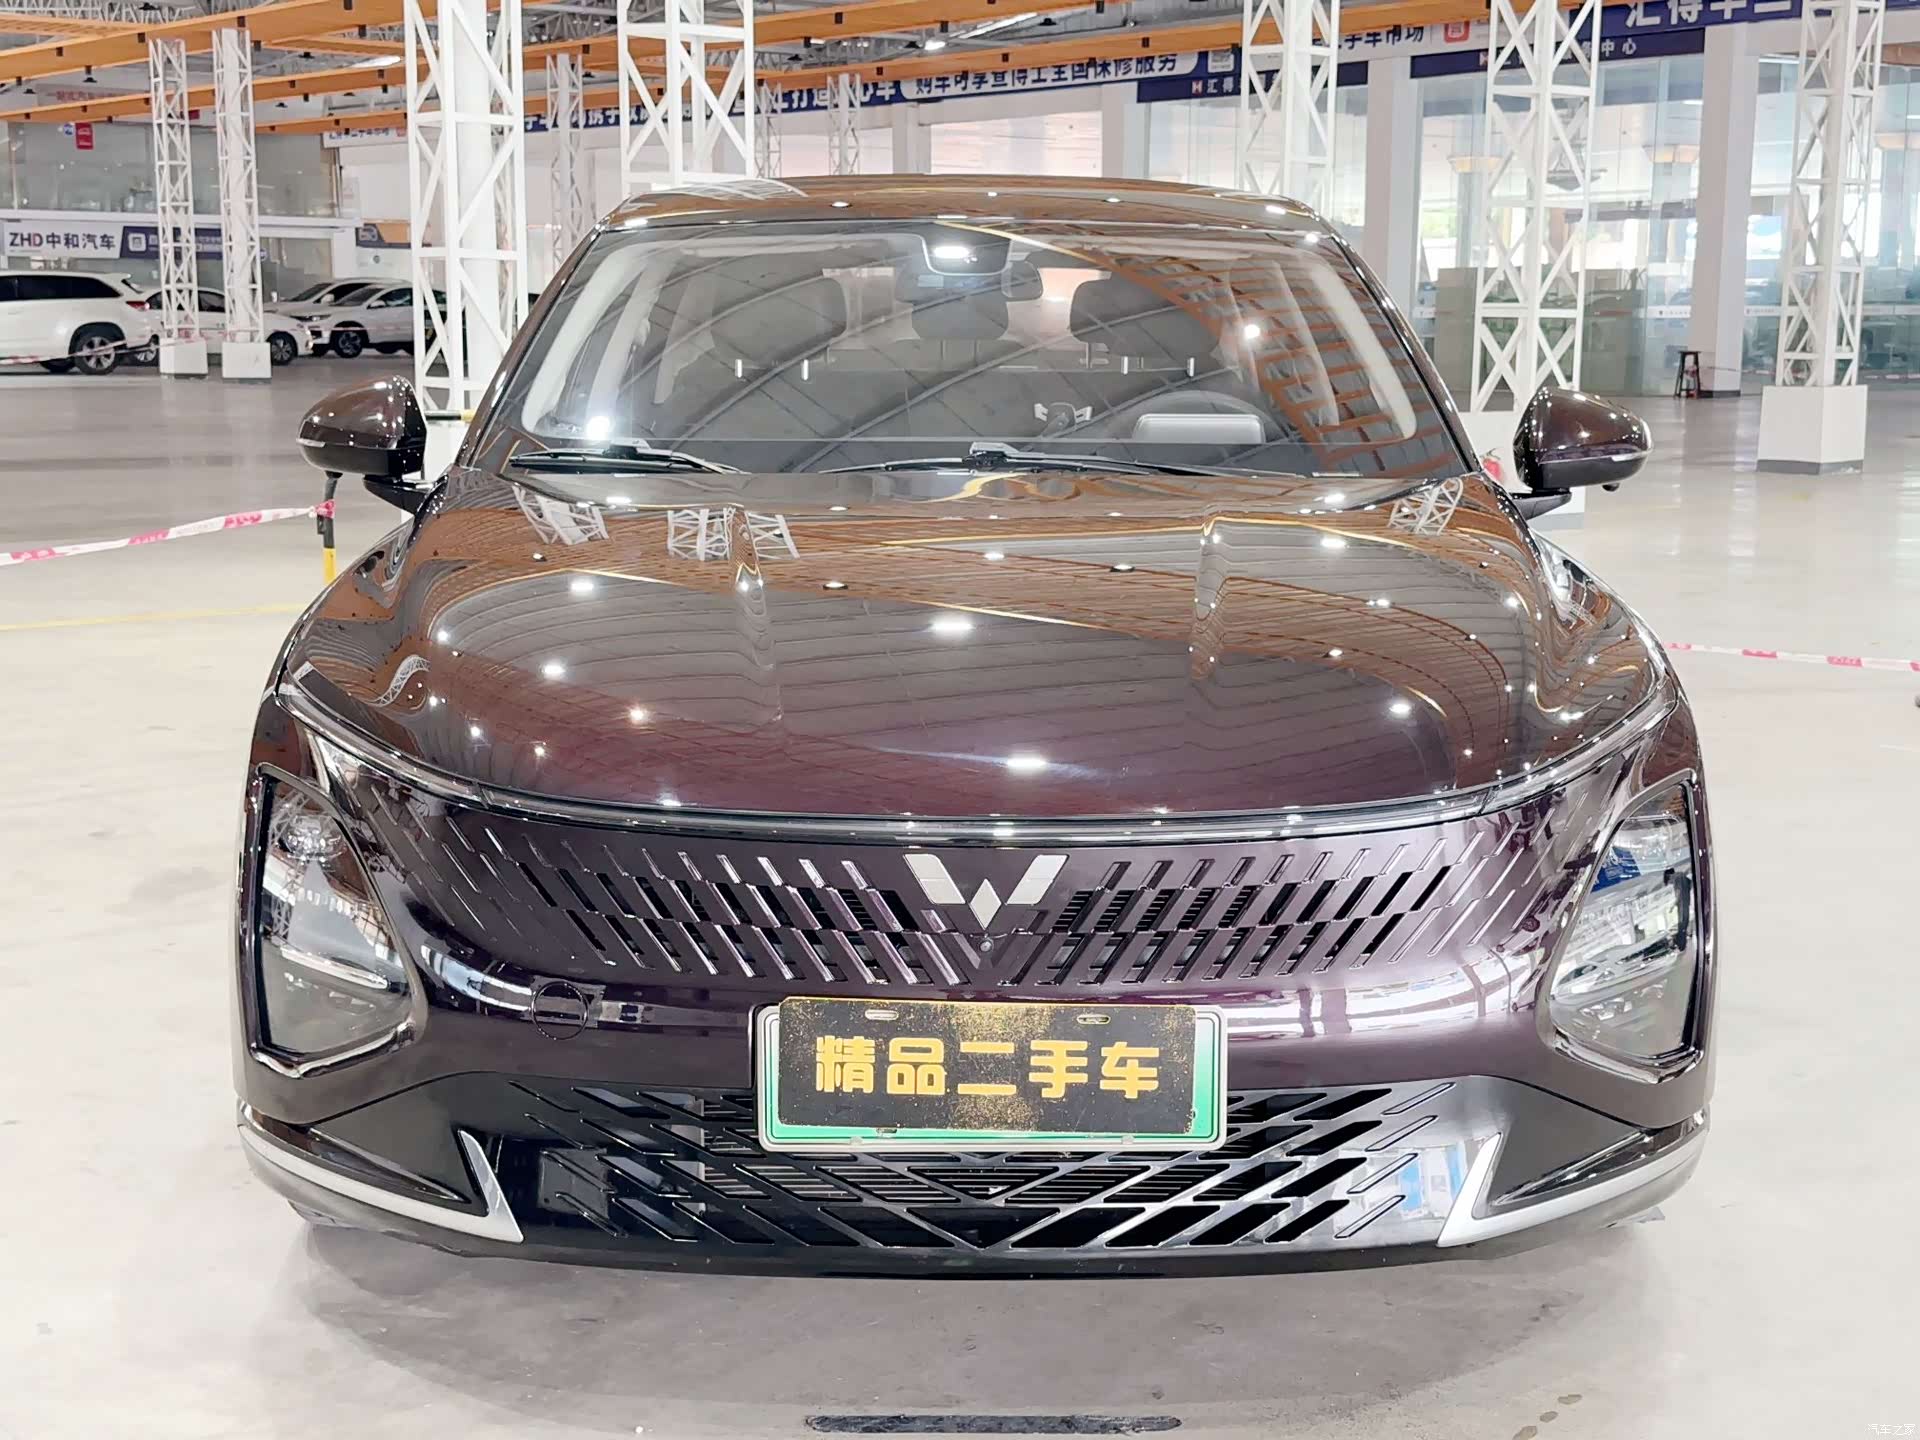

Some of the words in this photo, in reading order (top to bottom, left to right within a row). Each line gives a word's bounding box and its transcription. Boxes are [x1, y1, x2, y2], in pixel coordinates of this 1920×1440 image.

[9, 232, 43, 247] ZHD
[46, 232, 116, 251] 中和汽车
[816, 1034, 1160, 1099] 精品二手车
